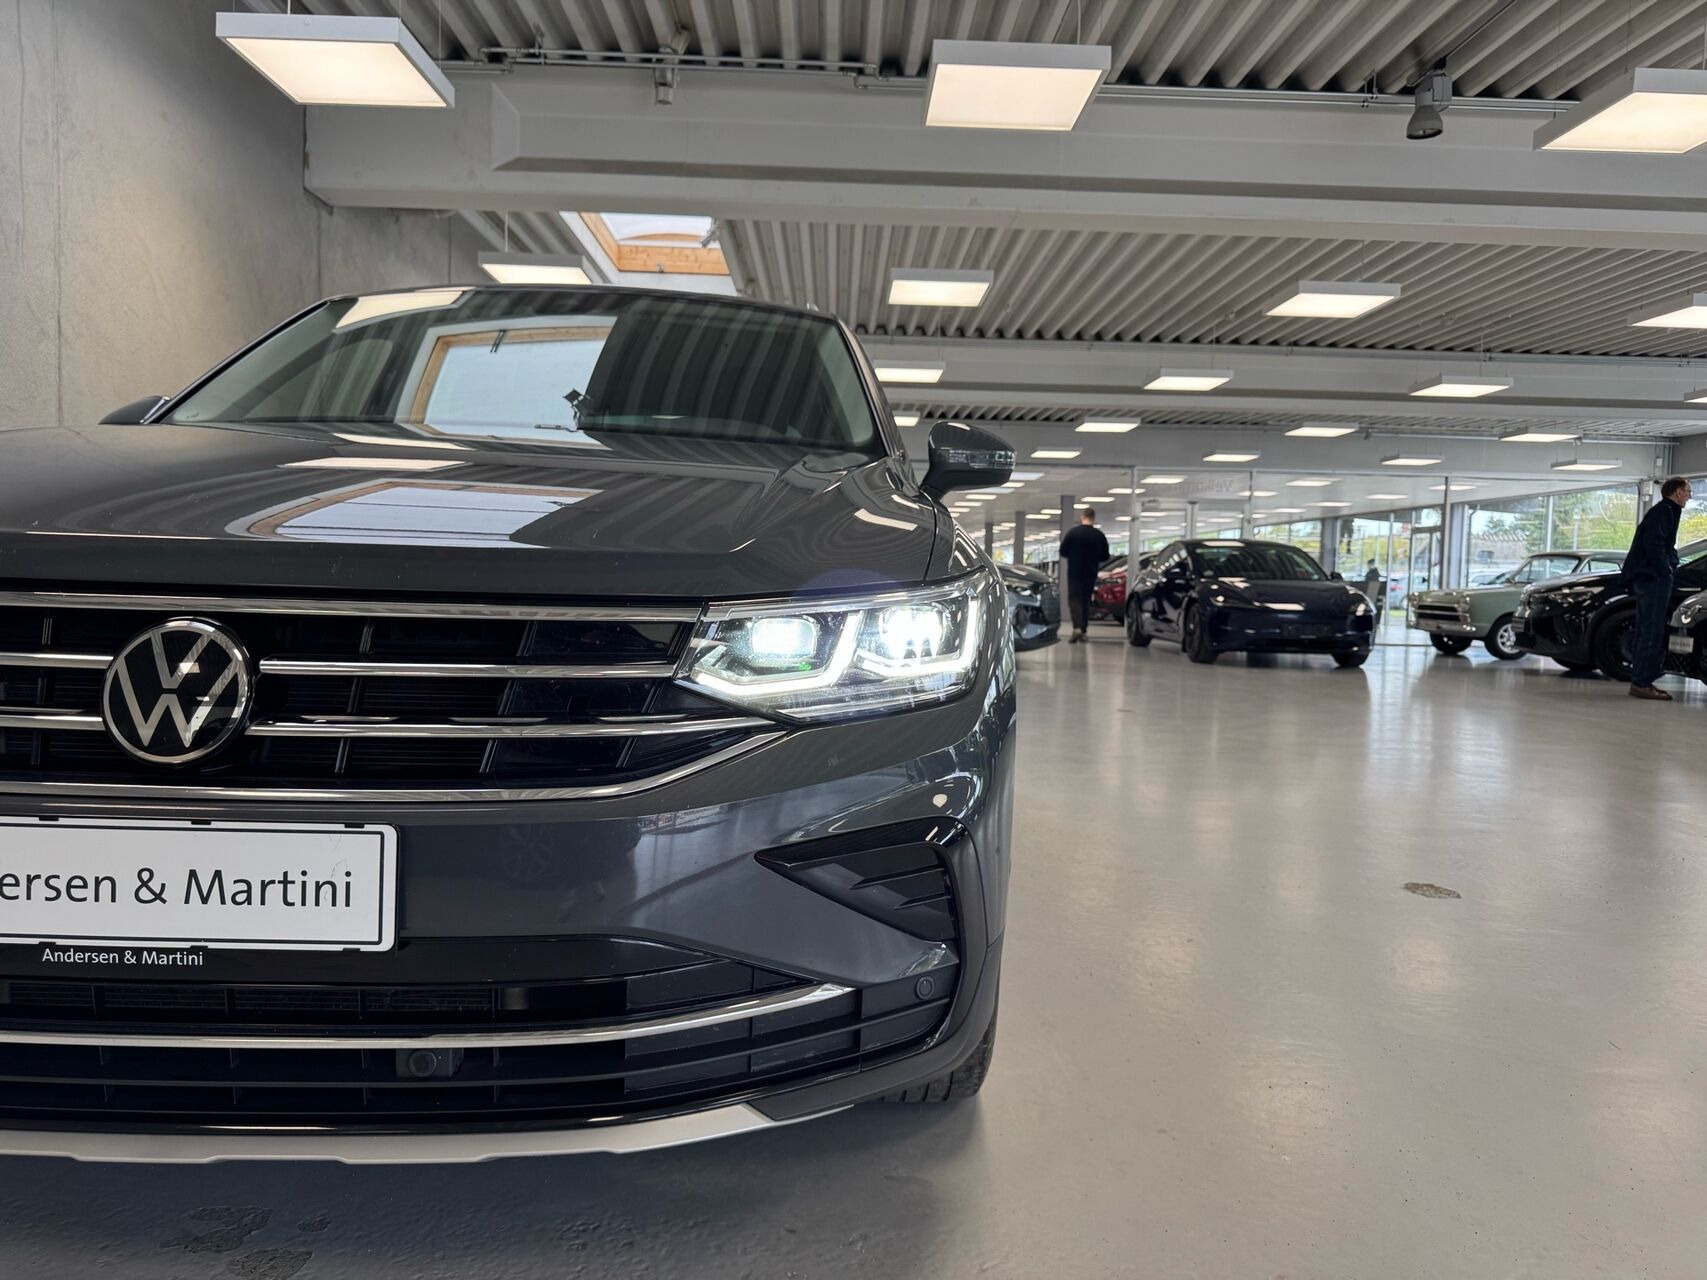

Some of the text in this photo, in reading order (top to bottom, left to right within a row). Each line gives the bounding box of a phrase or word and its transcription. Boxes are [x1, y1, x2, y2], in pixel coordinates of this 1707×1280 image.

[113, 629, 243, 748] VW
[0, 867, 352, 908] ersen & Martini
[42, 948, 203, 967] Andersen & Martini
